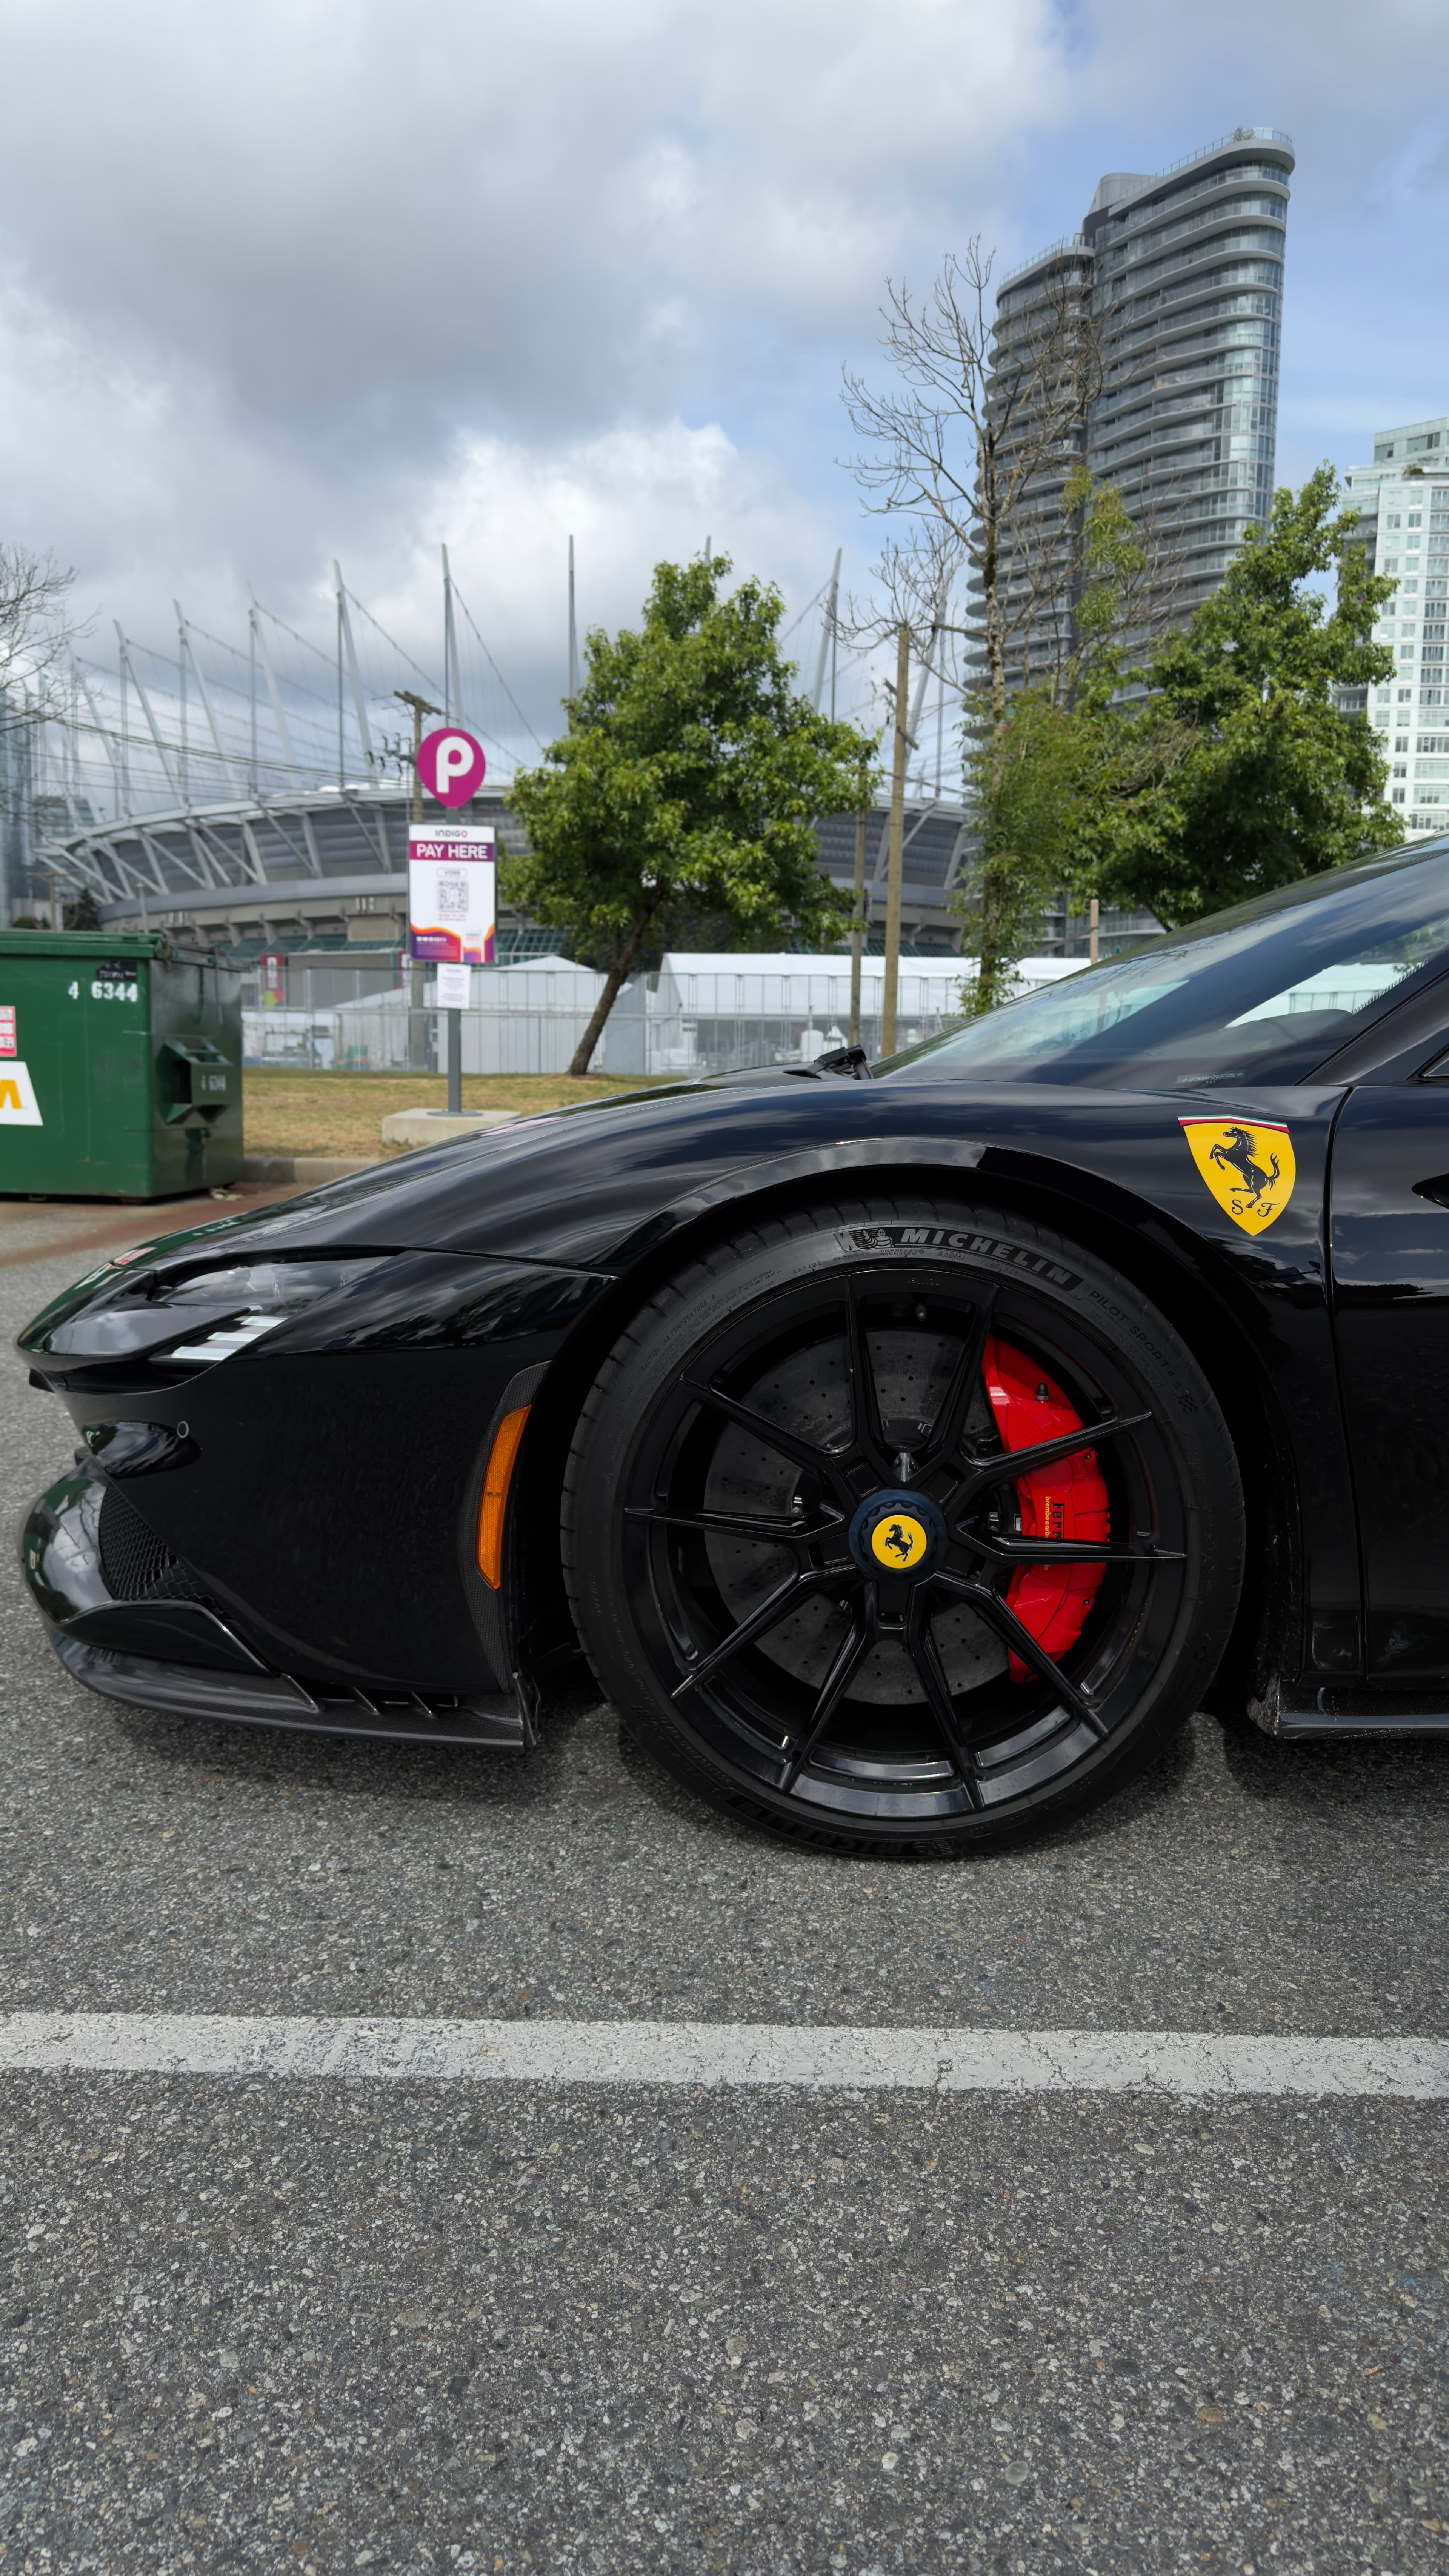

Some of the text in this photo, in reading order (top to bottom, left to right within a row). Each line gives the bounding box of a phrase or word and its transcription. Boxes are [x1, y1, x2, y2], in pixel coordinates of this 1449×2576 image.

[436, 736, 474, 793] P
[416, 843, 488, 859] PAY HERE
[68, 981, 138, 1002] 4 6344
[1231, 1199, 1280, 1217] S F
[900, 1228, 1073, 1285] MICHELIN
[938, 1251, 966, 1261] RADIAL
[980, 1258, 1019, 1276] TUBELESS
[1089, 1290, 1130, 1322] PILOT
[1129, 1326, 1173, 1368] SPORT
